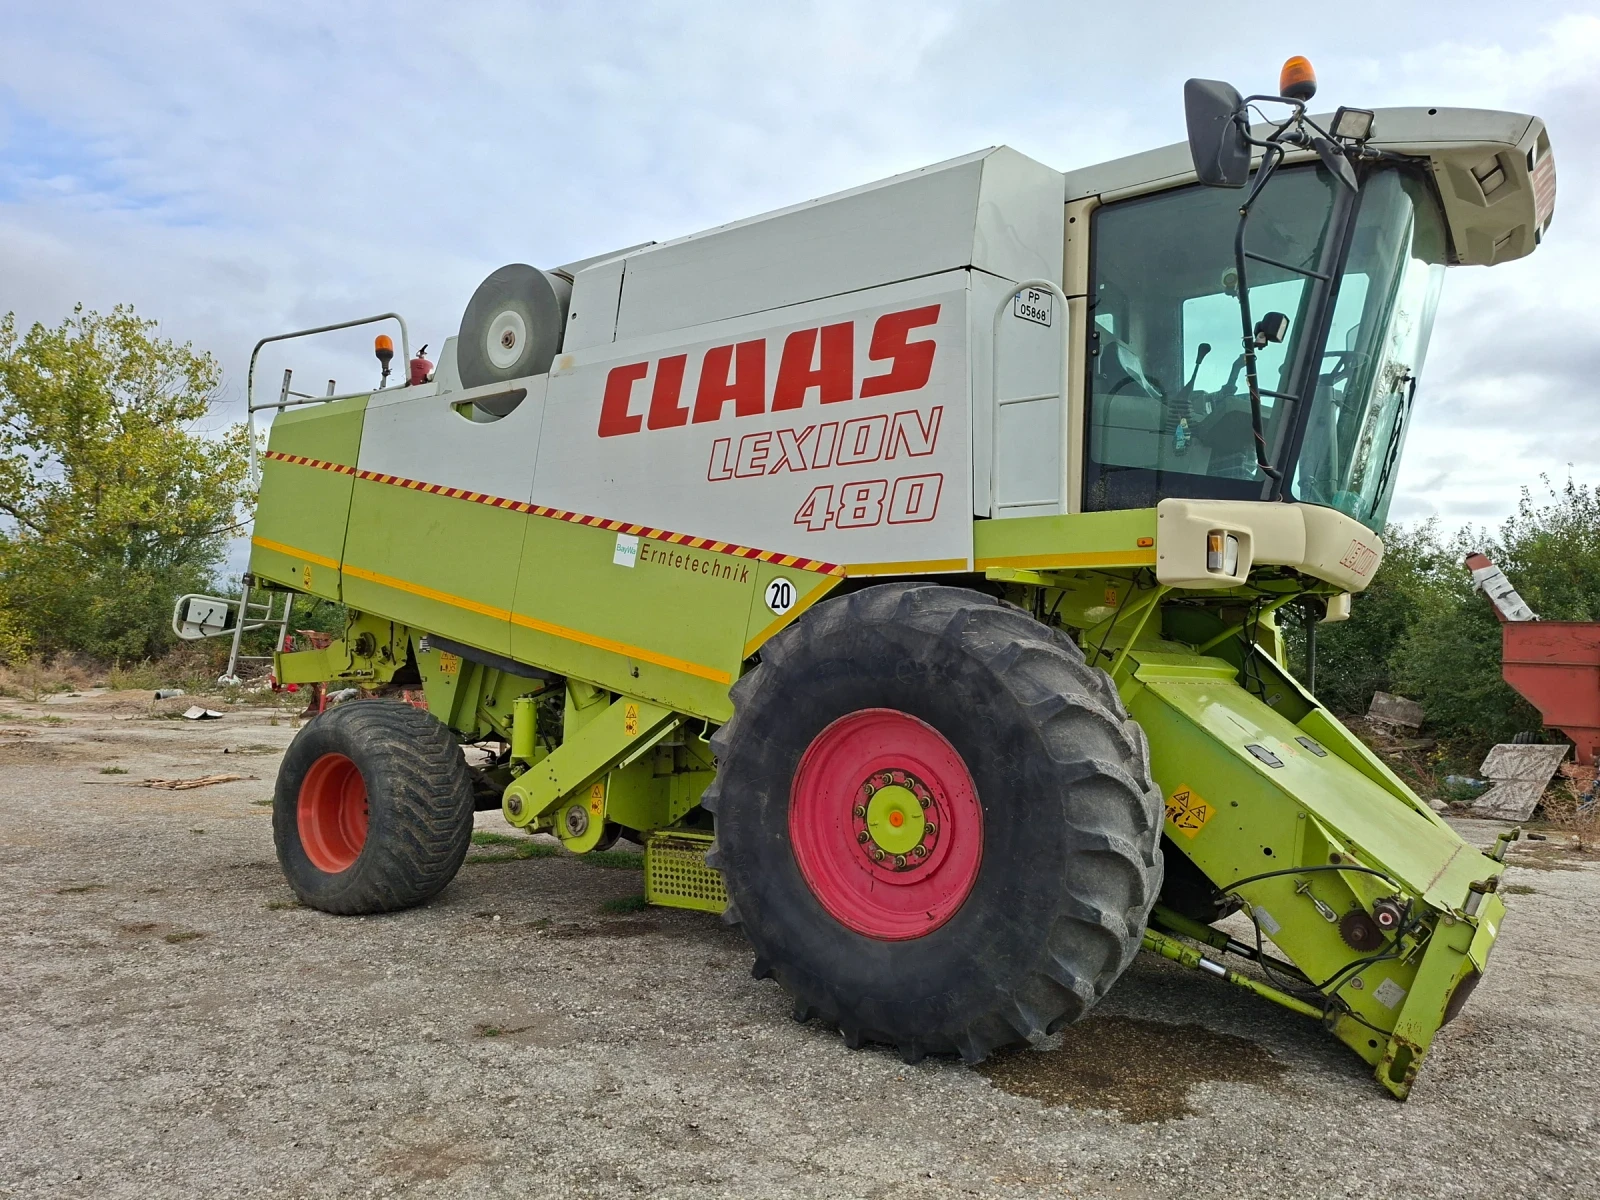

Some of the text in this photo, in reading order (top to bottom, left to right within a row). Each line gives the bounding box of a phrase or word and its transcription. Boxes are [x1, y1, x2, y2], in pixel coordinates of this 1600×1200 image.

[1020, 303, 1046, 321] 05868
[1028, 290, 1040, 304] PP
[598, 303, 941, 438] CLAAS
[707, 405, 943, 481] LEXION
[794, 473, 943, 532] 480
[616, 543, 636, 555] BayWa
[640, 543, 749, 583] Erntetechnik
[771, 582, 790, 609] 20
